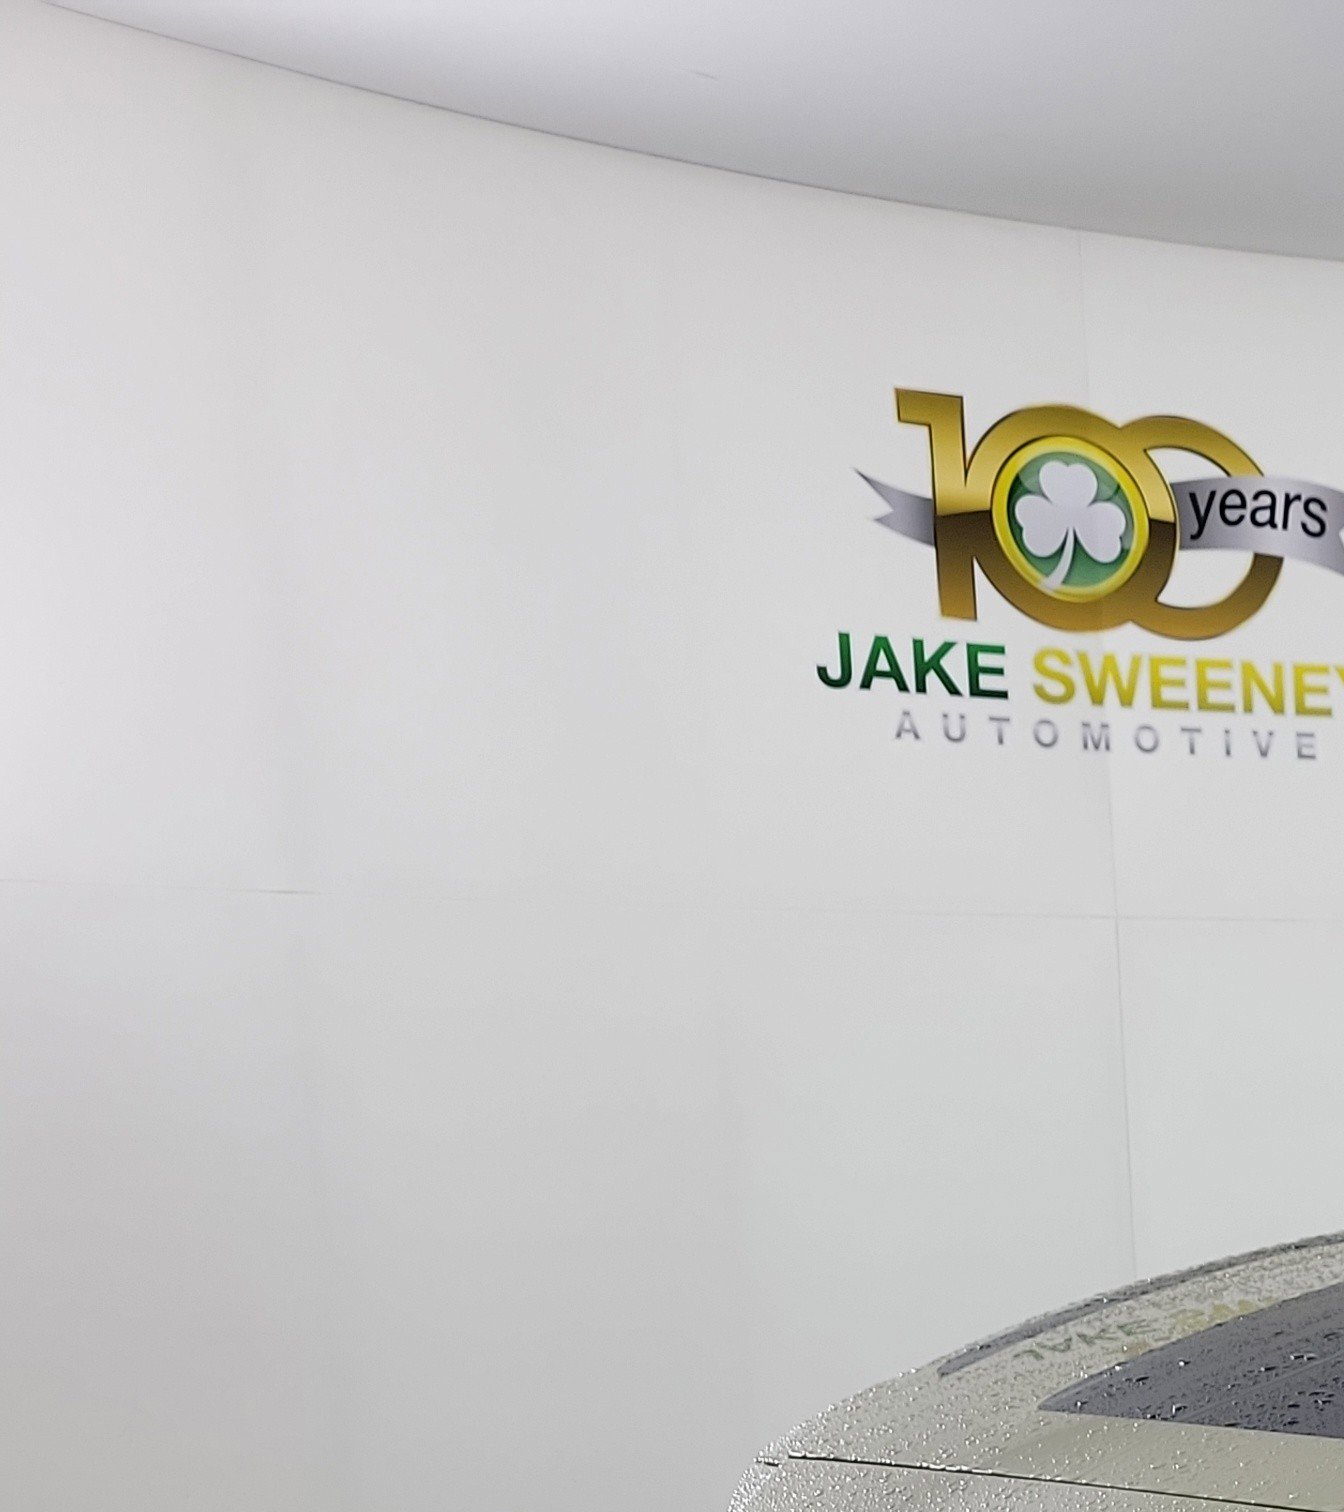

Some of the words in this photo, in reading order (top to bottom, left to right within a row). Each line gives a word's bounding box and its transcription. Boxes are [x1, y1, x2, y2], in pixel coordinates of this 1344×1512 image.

[894, 386, 1284, 641] 100
[1188, 488, 1328, 540] years
[815, 631, 1010, 701] JAKE
[894, 709, 1318, 761] AUTOMOTIVE
